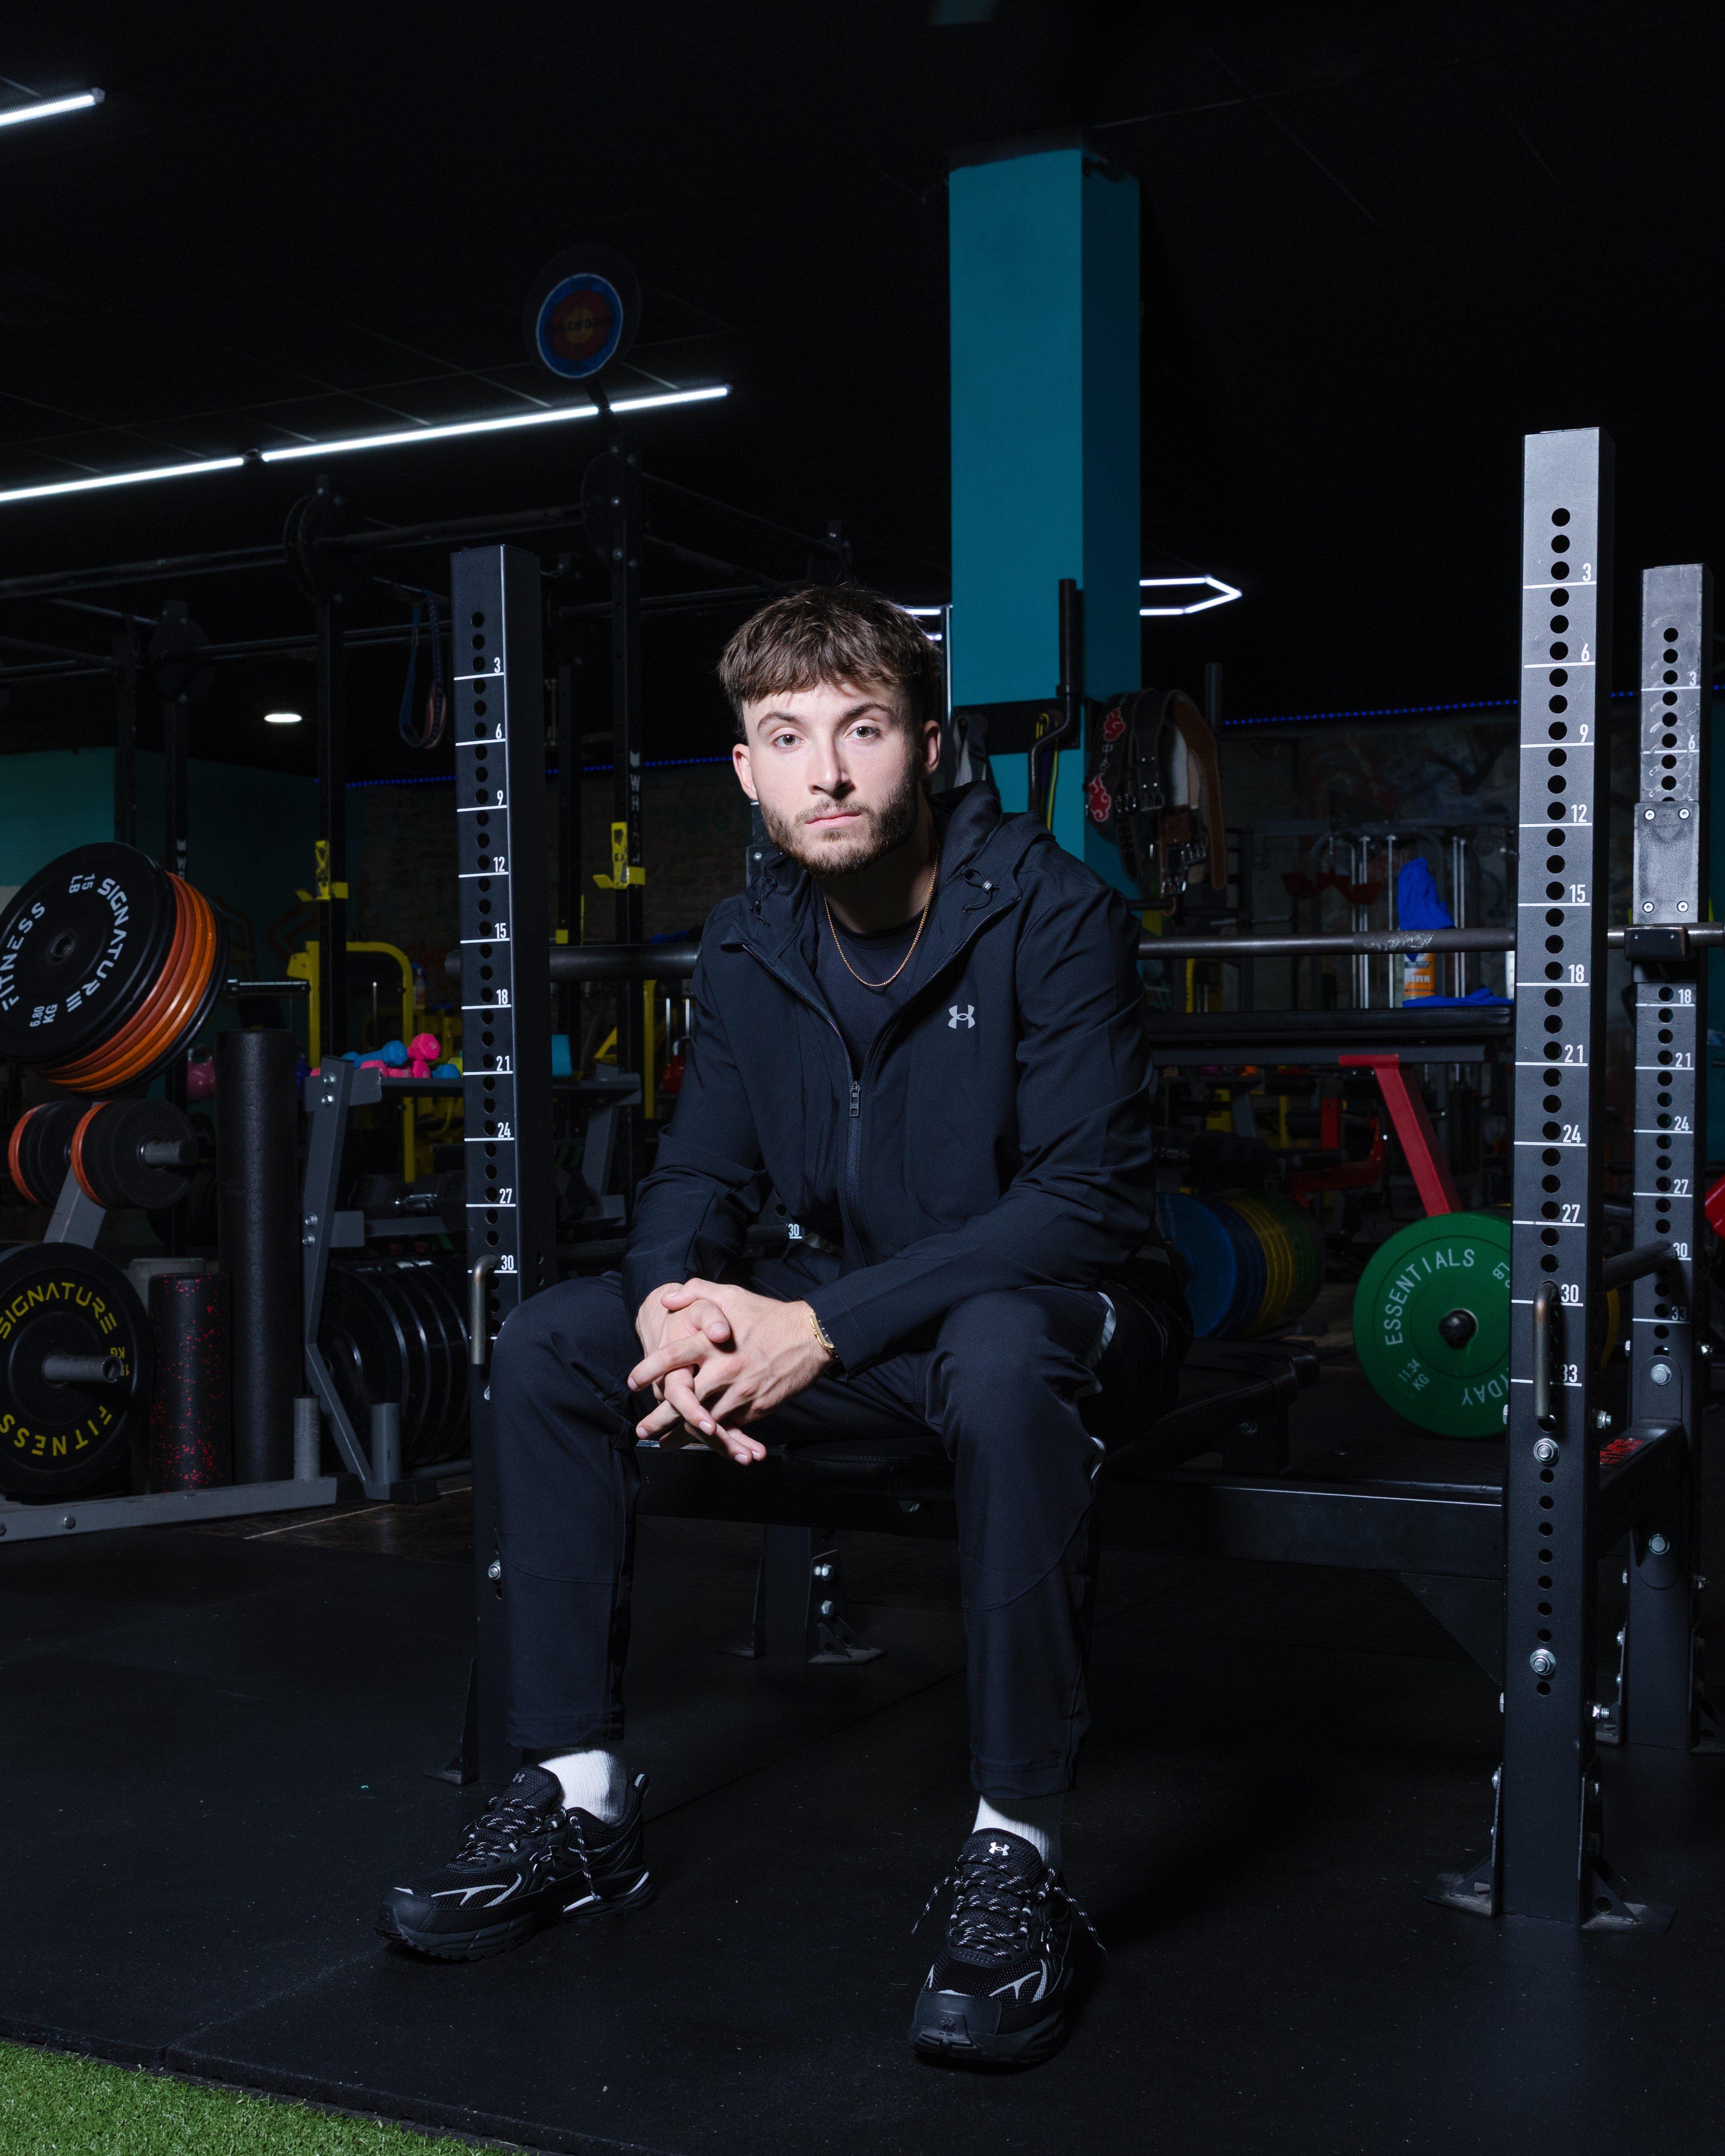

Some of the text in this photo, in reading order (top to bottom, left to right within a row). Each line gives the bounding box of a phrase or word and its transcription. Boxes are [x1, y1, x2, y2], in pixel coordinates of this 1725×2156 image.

[1583, 563, 1591, 582] 3
[1581, 644, 1590, 662] 6
[494, 657, 501, 673] 3
[1689, 672, 1697, 687] 3
[496, 723, 502, 739] 6
[1580, 724, 1589, 742] 9
[1689, 735, 1695, 750] 6
[497, 790, 503, 806] 9
[1571, 804, 1587, 823] 12
[493, 856, 505, 872] 12
[69, 874, 83, 894] LB
[82, 873, 96, 891] 15
[1570, 884, 1586, 902] 15
[495, 923, 506, 939] 15
[66, 878, 129, 1012] SIGNATURE
[0, 902, 45, 1011] FITNESS
[1568, 964, 1585, 983] 18
[496, 989, 508, 1005] 18
[1678, 989, 1692, 1003] 18
[29, 1006, 45, 1027] 6.80
[42, 1004, 58, 1024] KG
[1564, 1045, 1583, 1063] 21
[1675, 1053, 1691, 1067] 21
[496, 1056, 510, 1071] 21
[498, 1123, 511, 1138] 24
[1674, 1116, 1689, 1131] 24
[1563, 1125, 1581, 1143] 24
[1673, 1179, 1689, 1194] 27
[499, 1188, 512, 1204] 27
[1562, 1204, 1580, 1222] 27
[788, 1224, 800, 1236] 30
[1673, 1243, 1688, 1258] 30
[501, 1255, 514, 1271] 30
[1493, 1262, 1510, 1279] LB
[1383, 1248, 1475, 1346] ESSENTIALS
[1561, 1284, 1579, 1303] 30
[0, 1282, 117, 1339] SIGNATURE
[1671, 1306, 1686, 1321] 33
[110, 1347, 125, 1359] KG
[1398, 1359, 1421, 1381] 11.34
[1560, 1364, 1578, 1382] 33
[1412, 1373, 1430, 1391] KG
[0, 1406, 112, 1456] FITNESS
